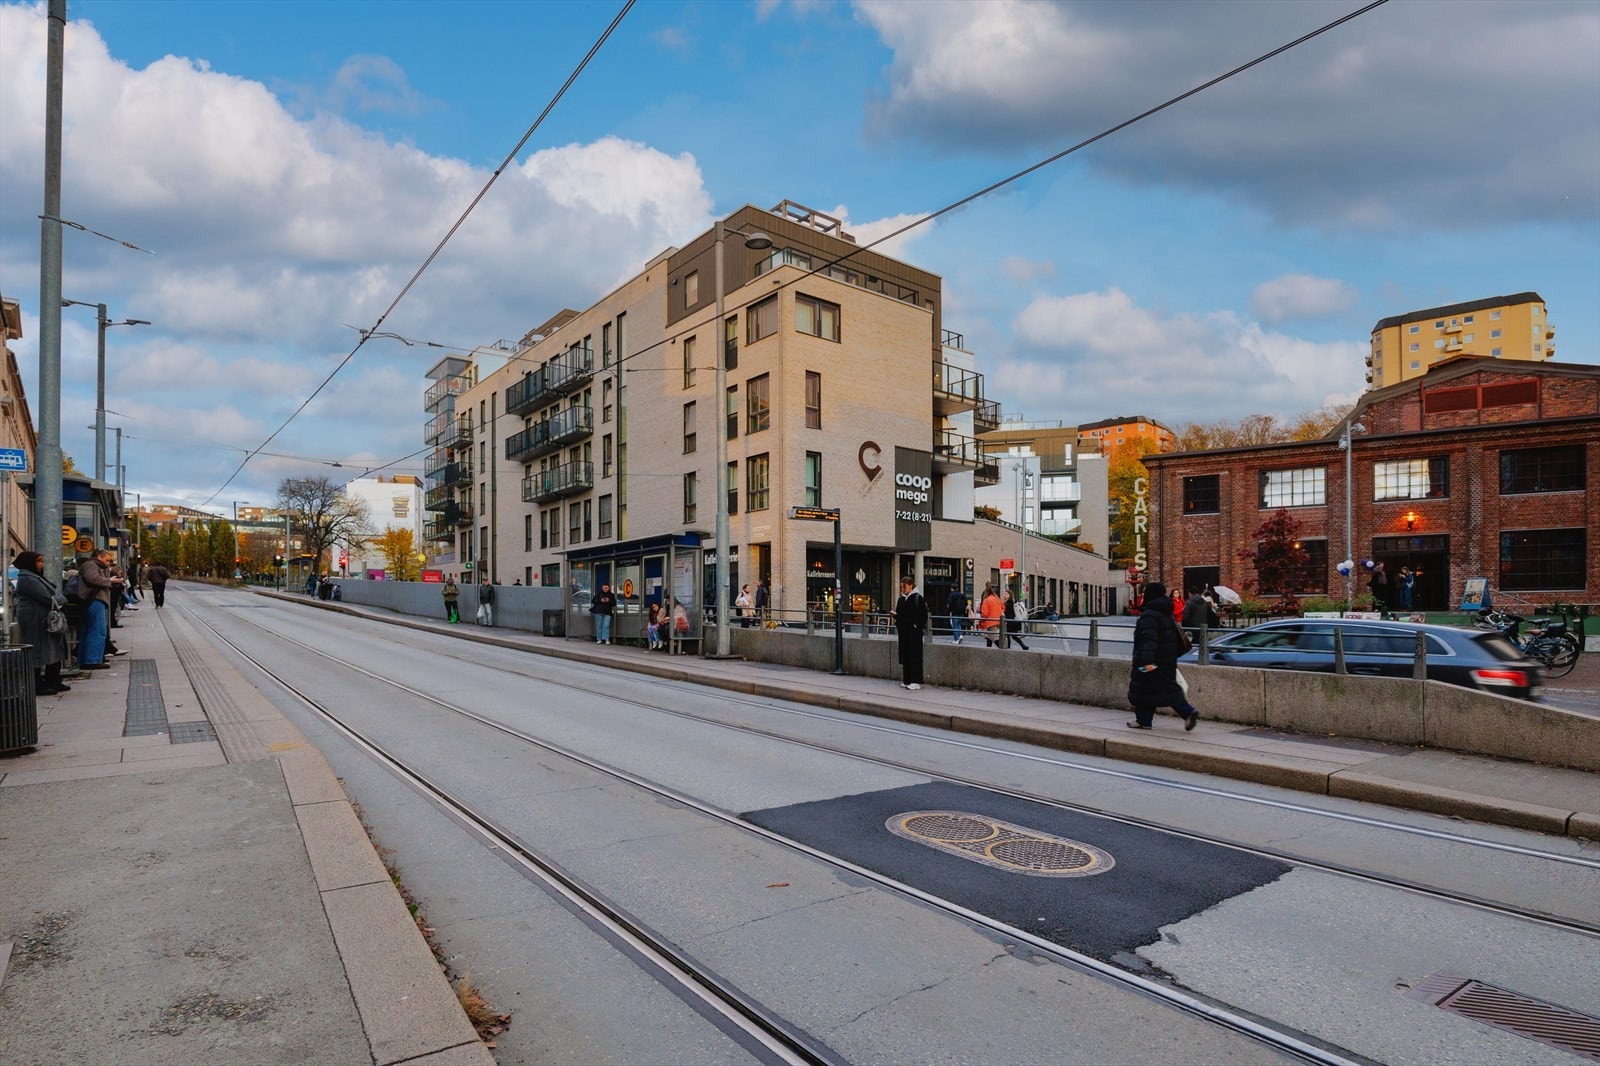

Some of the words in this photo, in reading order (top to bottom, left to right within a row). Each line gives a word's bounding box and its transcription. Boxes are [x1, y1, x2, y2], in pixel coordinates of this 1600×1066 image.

[896, 473, 932, 491] coop
[896, 489, 928, 505] mega
[1134, 477, 1148, 571] CARLS
[80, 541, 87, 550] E
